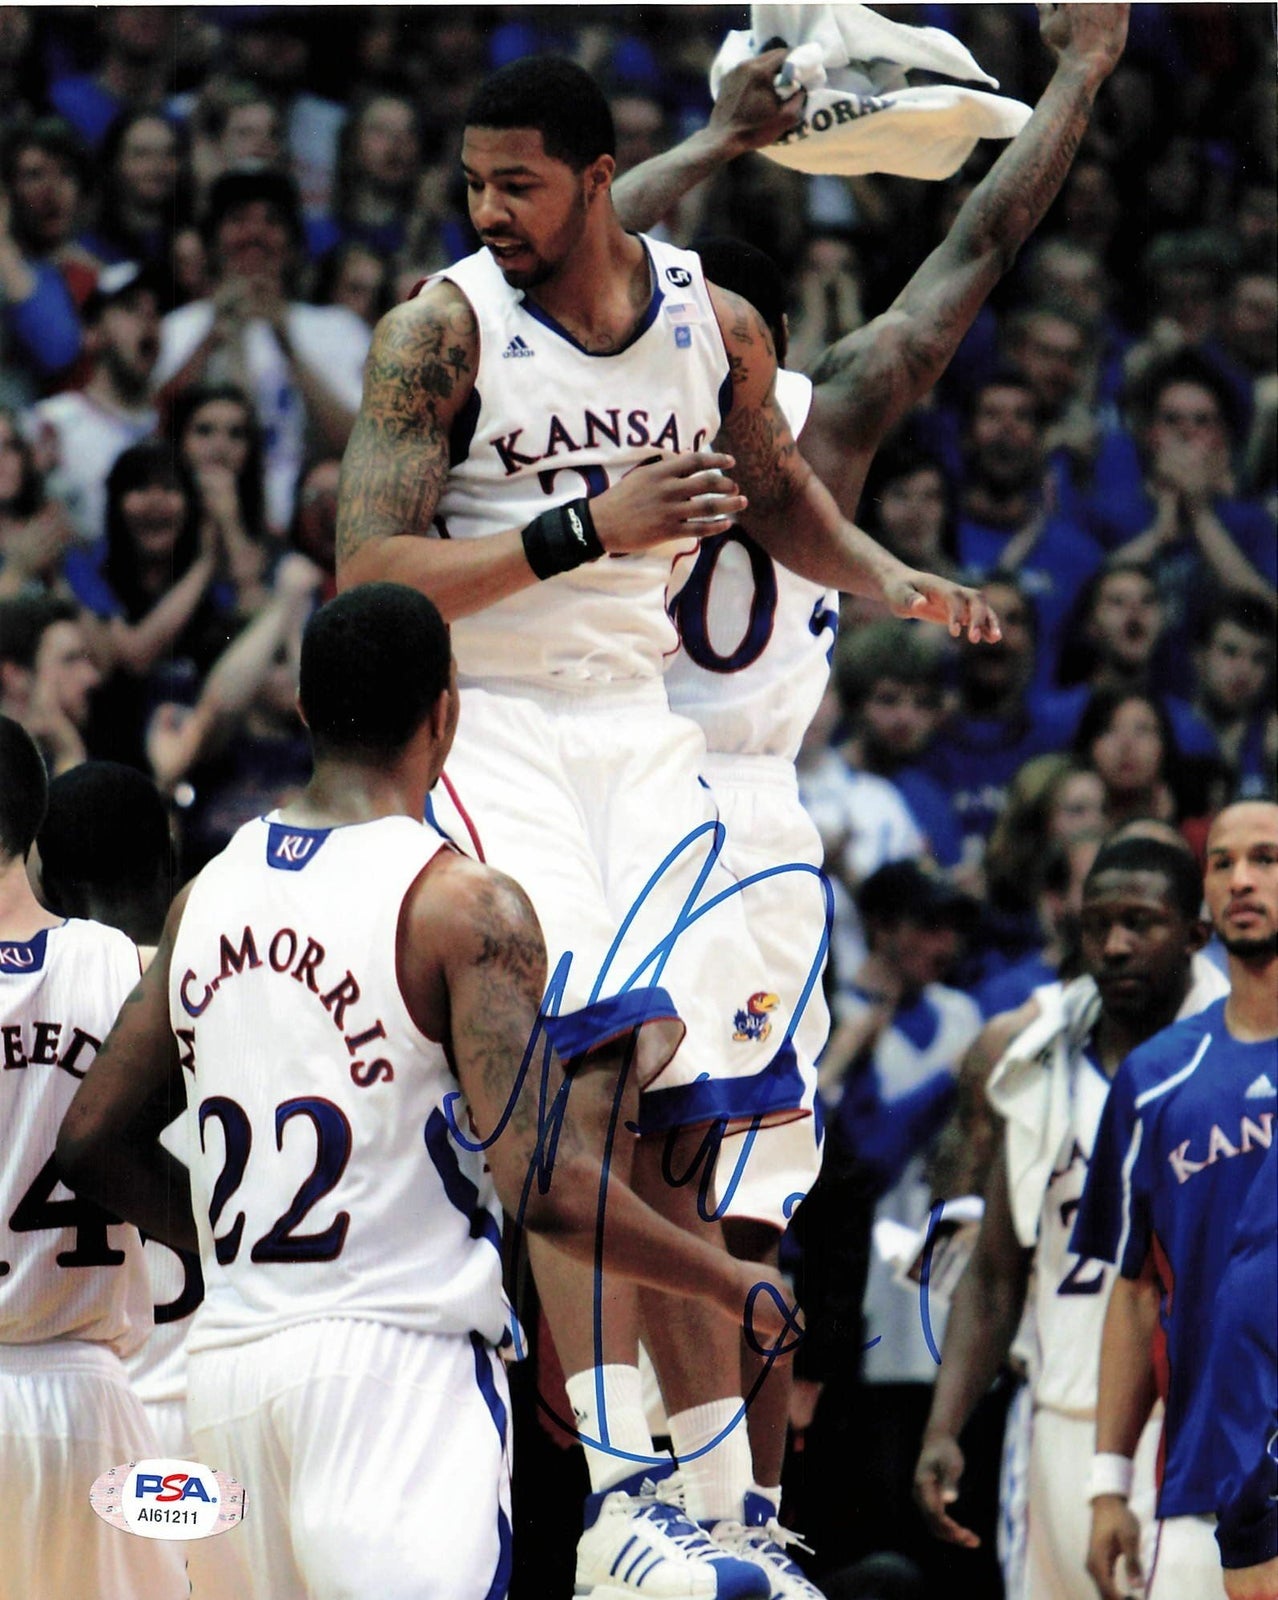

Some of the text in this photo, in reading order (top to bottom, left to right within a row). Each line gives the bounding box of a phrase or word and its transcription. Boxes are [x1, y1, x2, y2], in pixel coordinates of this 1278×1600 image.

[276, 835, 314, 862] KU
[0, 947, 34, 968] KU
[1168, 1112, 1274, 1185] KAN
[200, 1096, 352, 1265] 22
